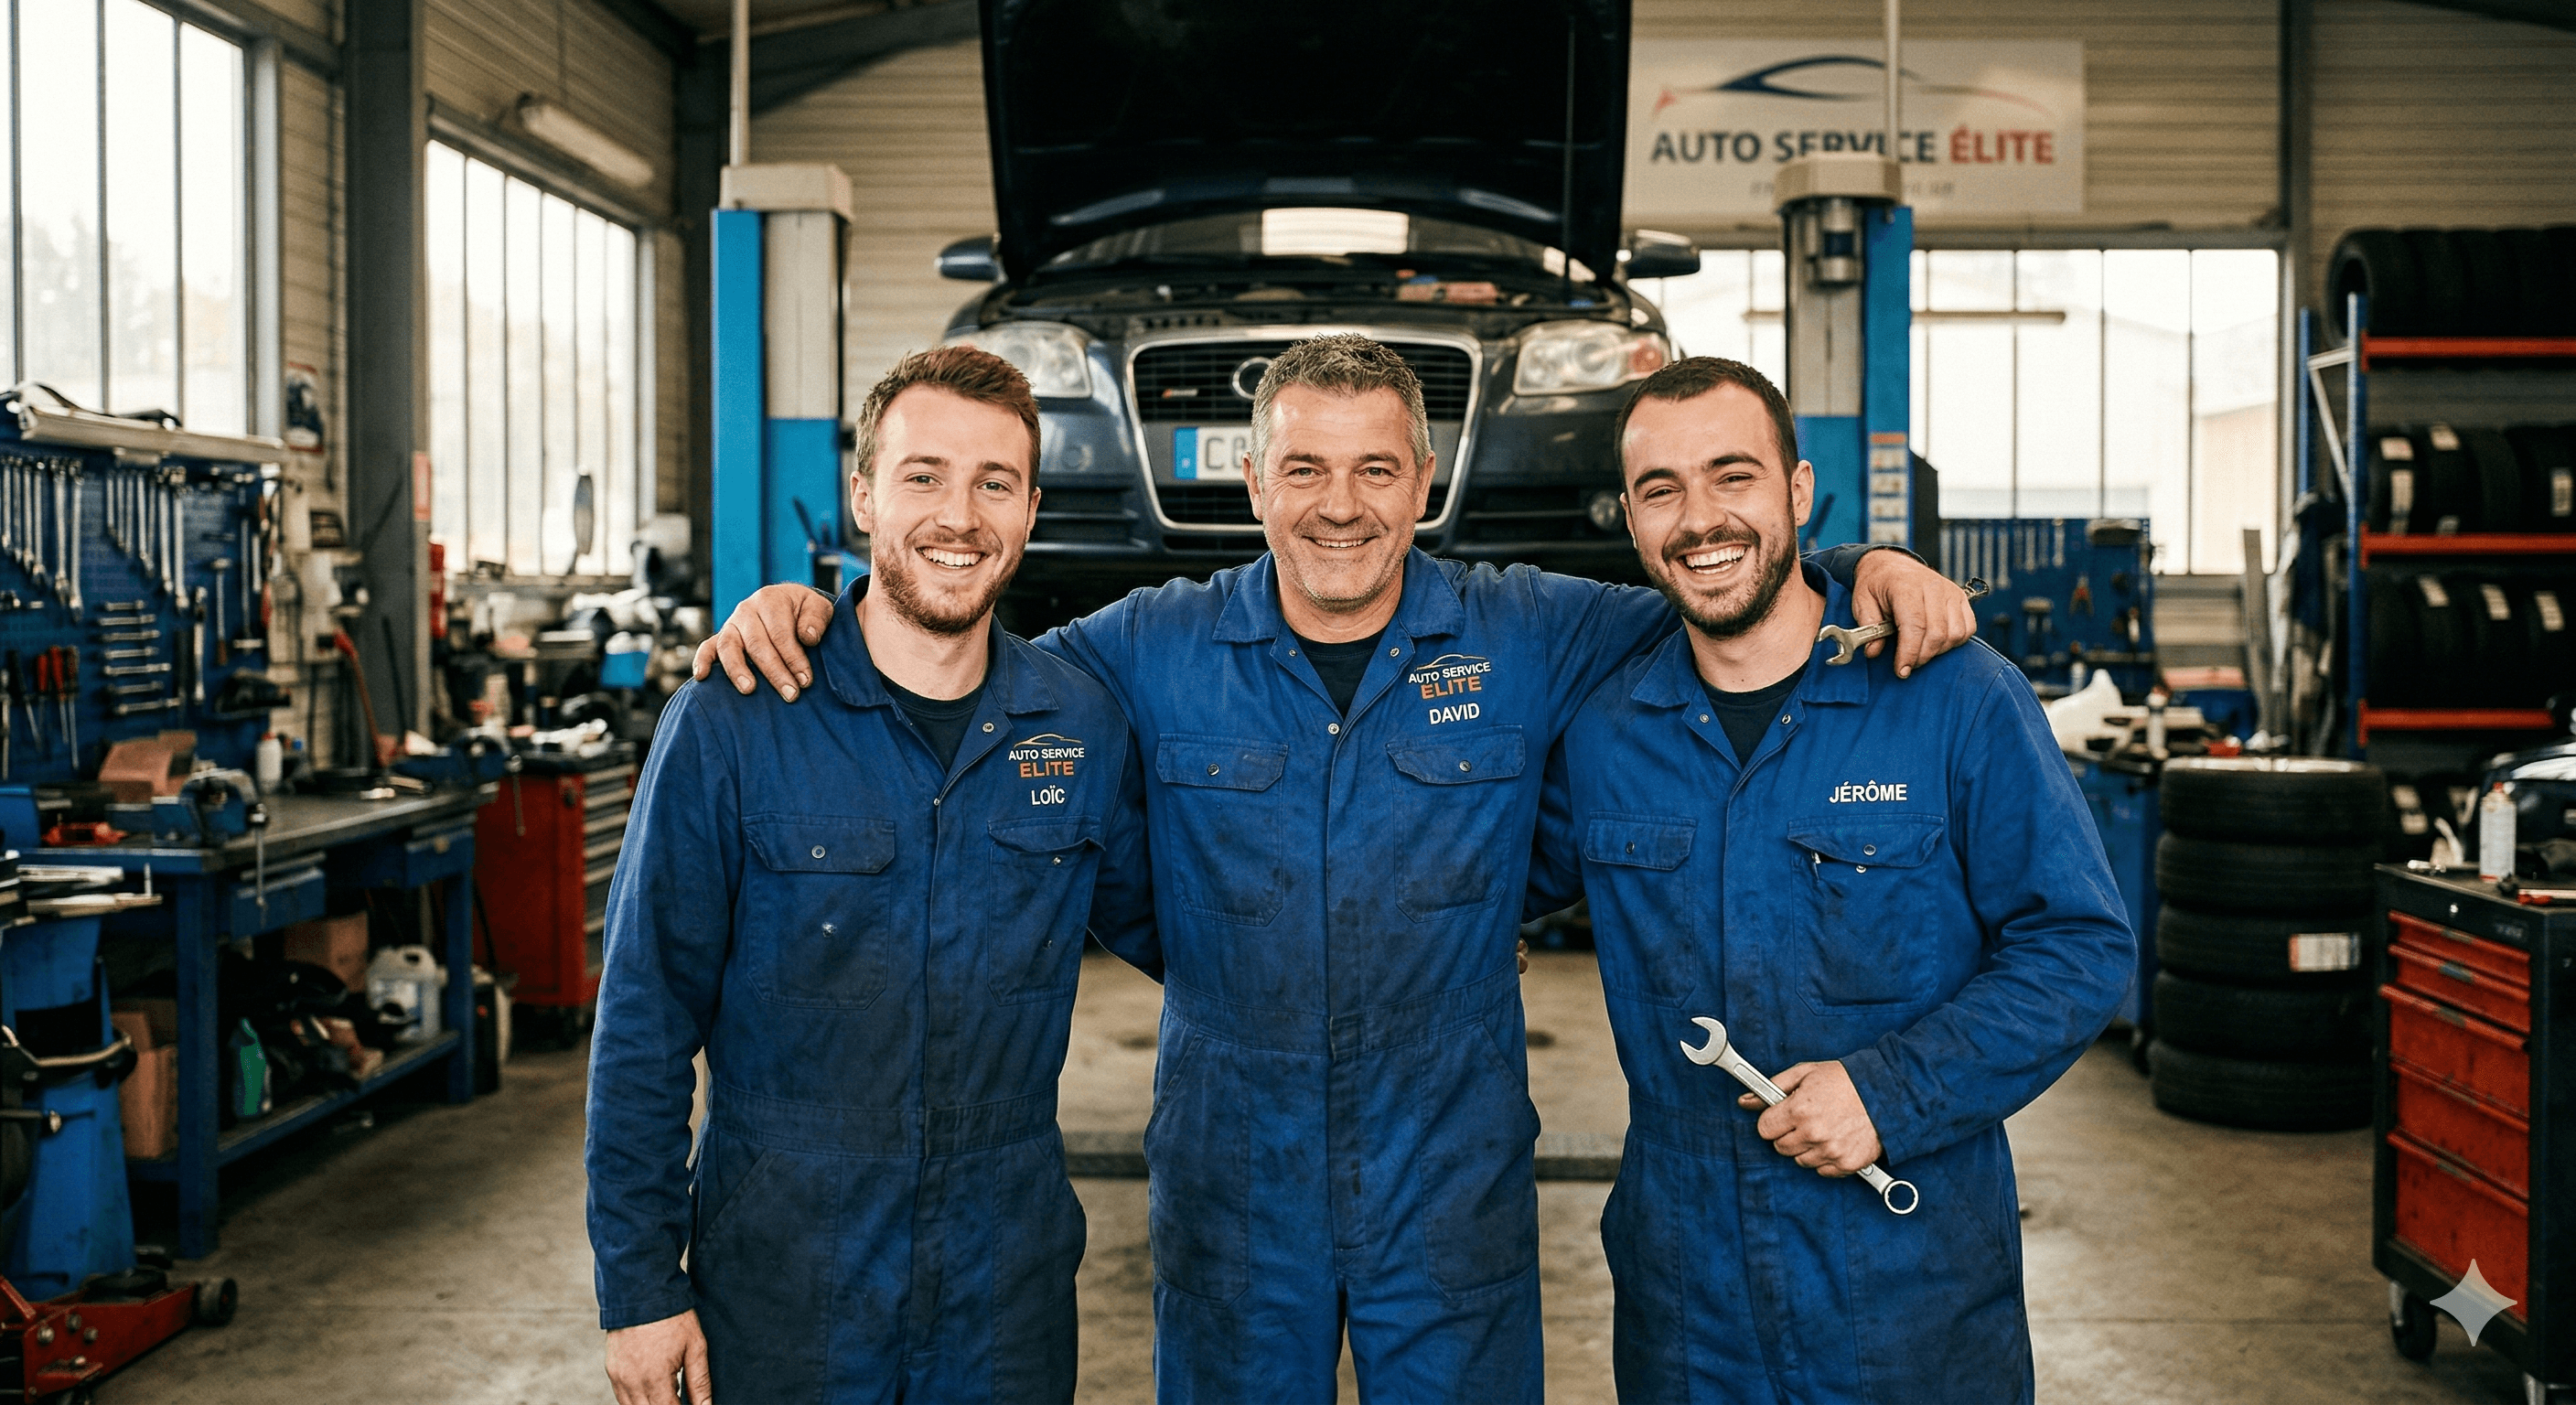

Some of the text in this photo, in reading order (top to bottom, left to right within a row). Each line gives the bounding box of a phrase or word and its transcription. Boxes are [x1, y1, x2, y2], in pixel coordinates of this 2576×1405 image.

[1650, 130, 1762, 164] AUTO
[1948, 123, 2055, 164] ÉLITE
[1408, 662, 1491, 684] AUTO SERVICE
[1429, 702, 1480, 724] DAVID
[1008, 746, 1085, 761] AUTO SERVICE
[1019, 760, 1075, 778] ELITE
[1030, 784, 1066, 806] LOÏC
[1829, 779, 1908, 804] JÉRÔME
